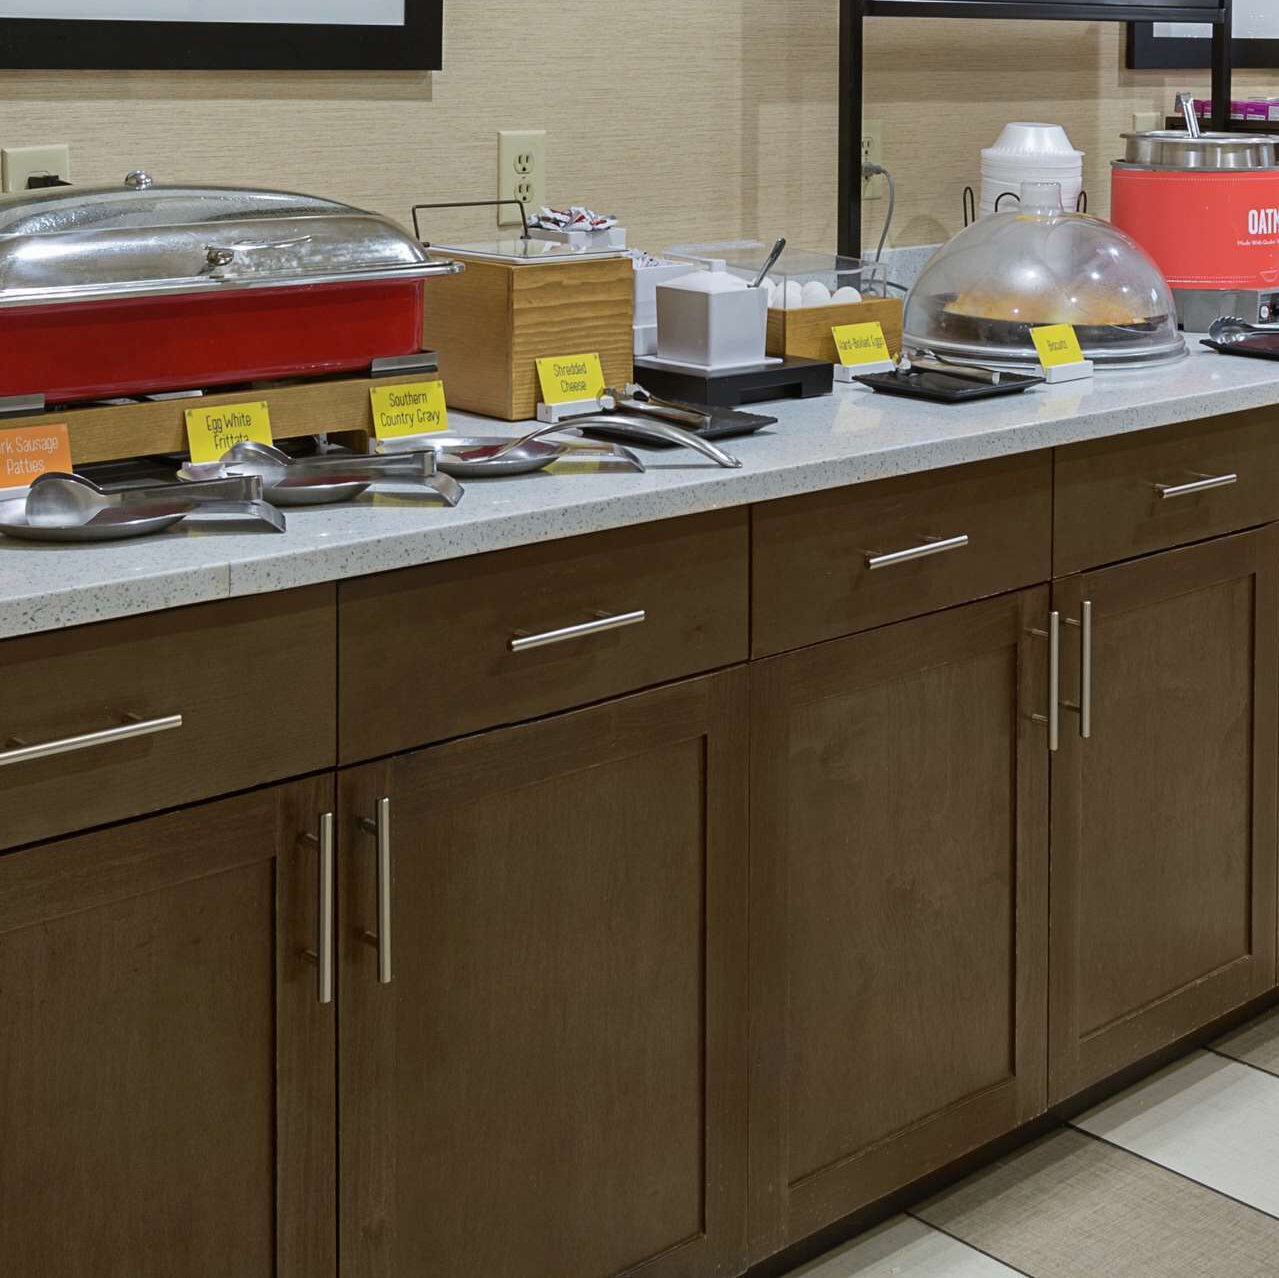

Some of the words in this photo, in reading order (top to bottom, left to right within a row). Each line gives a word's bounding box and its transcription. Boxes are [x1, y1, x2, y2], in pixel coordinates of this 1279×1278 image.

[553, 362, 588, 378] Shredded
[560, 379, 587, 394] Cheese
[388, 391, 428, 408] Southern
[205, 414, 223, 434] Egg
[222, 411, 252, 428] White
[380, 411, 414, 428] Country
[416, 408, 441, 426] Gravy
[15, 435, 59, 454] Sausage
[6, 457, 45, 475] Patties
